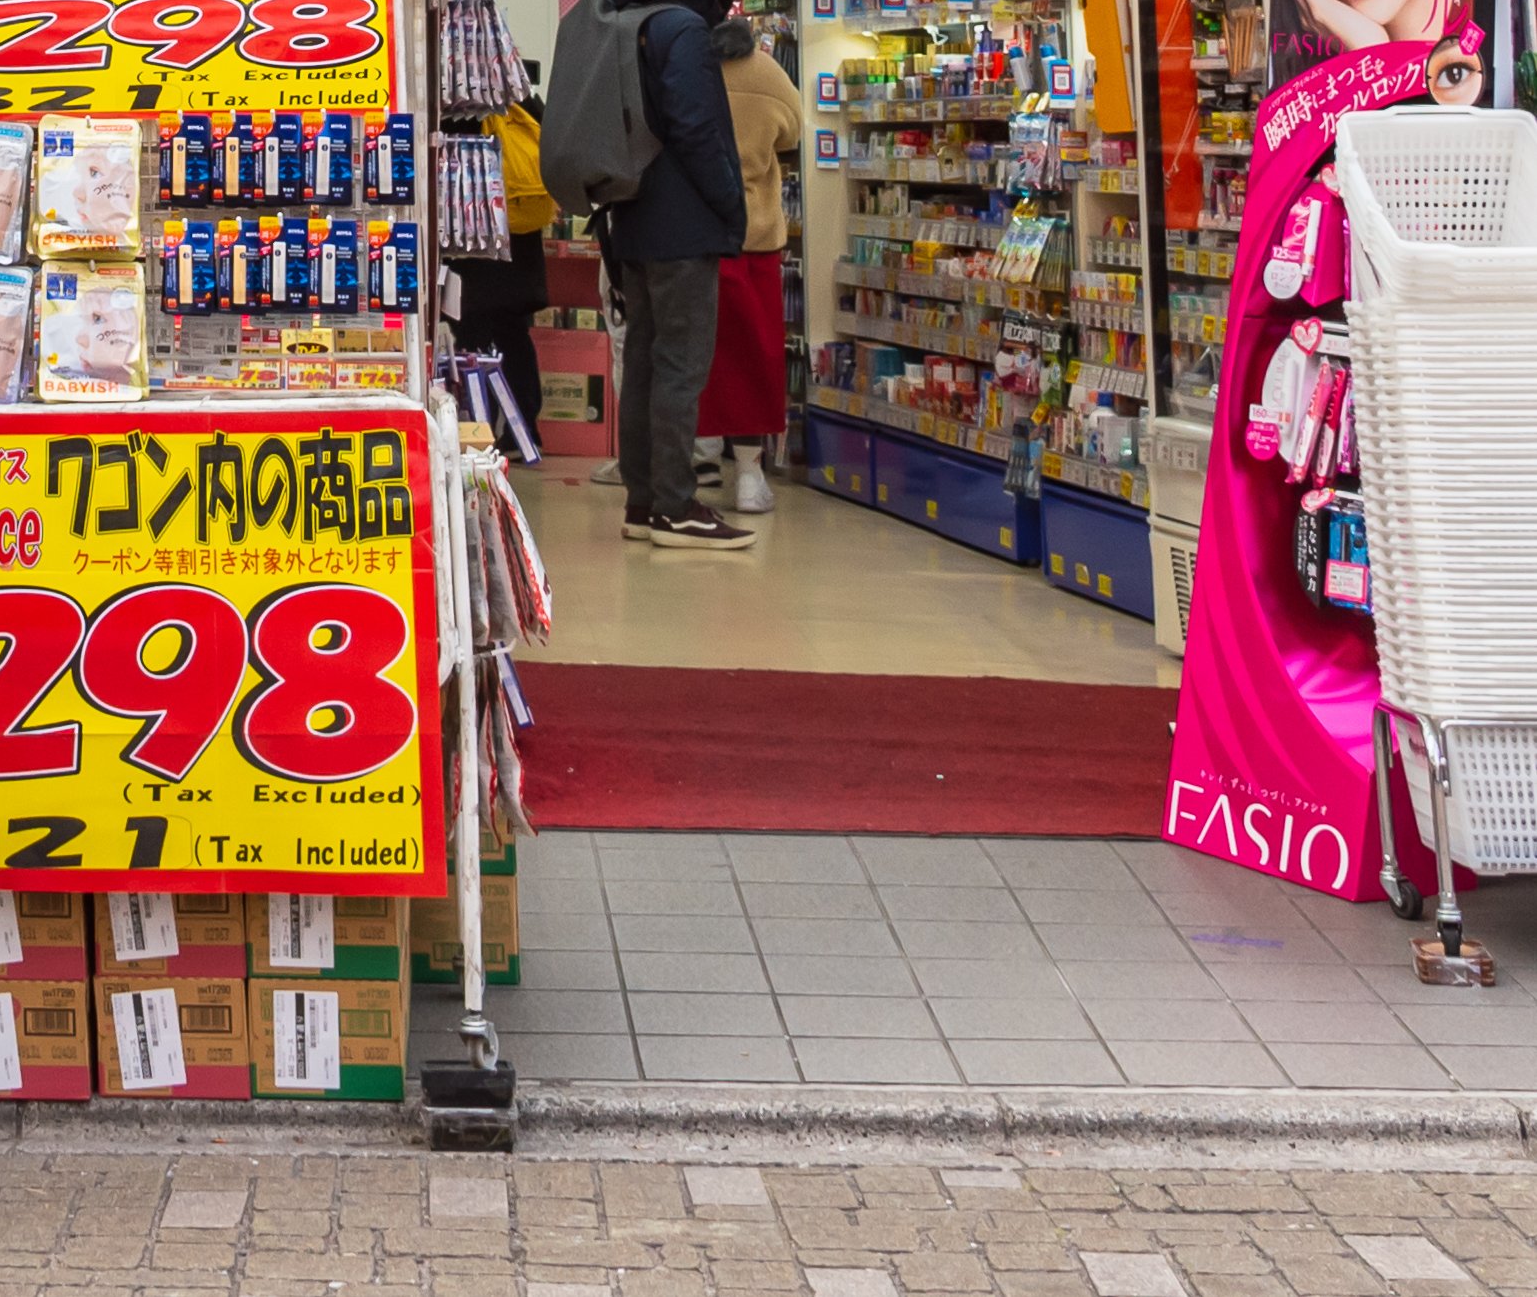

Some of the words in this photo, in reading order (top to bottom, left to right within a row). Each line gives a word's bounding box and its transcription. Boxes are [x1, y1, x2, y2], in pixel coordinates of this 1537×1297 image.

[44, 381, 119, 393] BABYISH
[45, 428, 414, 543] ワゴン内の商品
[73, 547, 404, 575] クーポン等割引き対象外となります
[1167, 779, 1350, 890] FASIO
